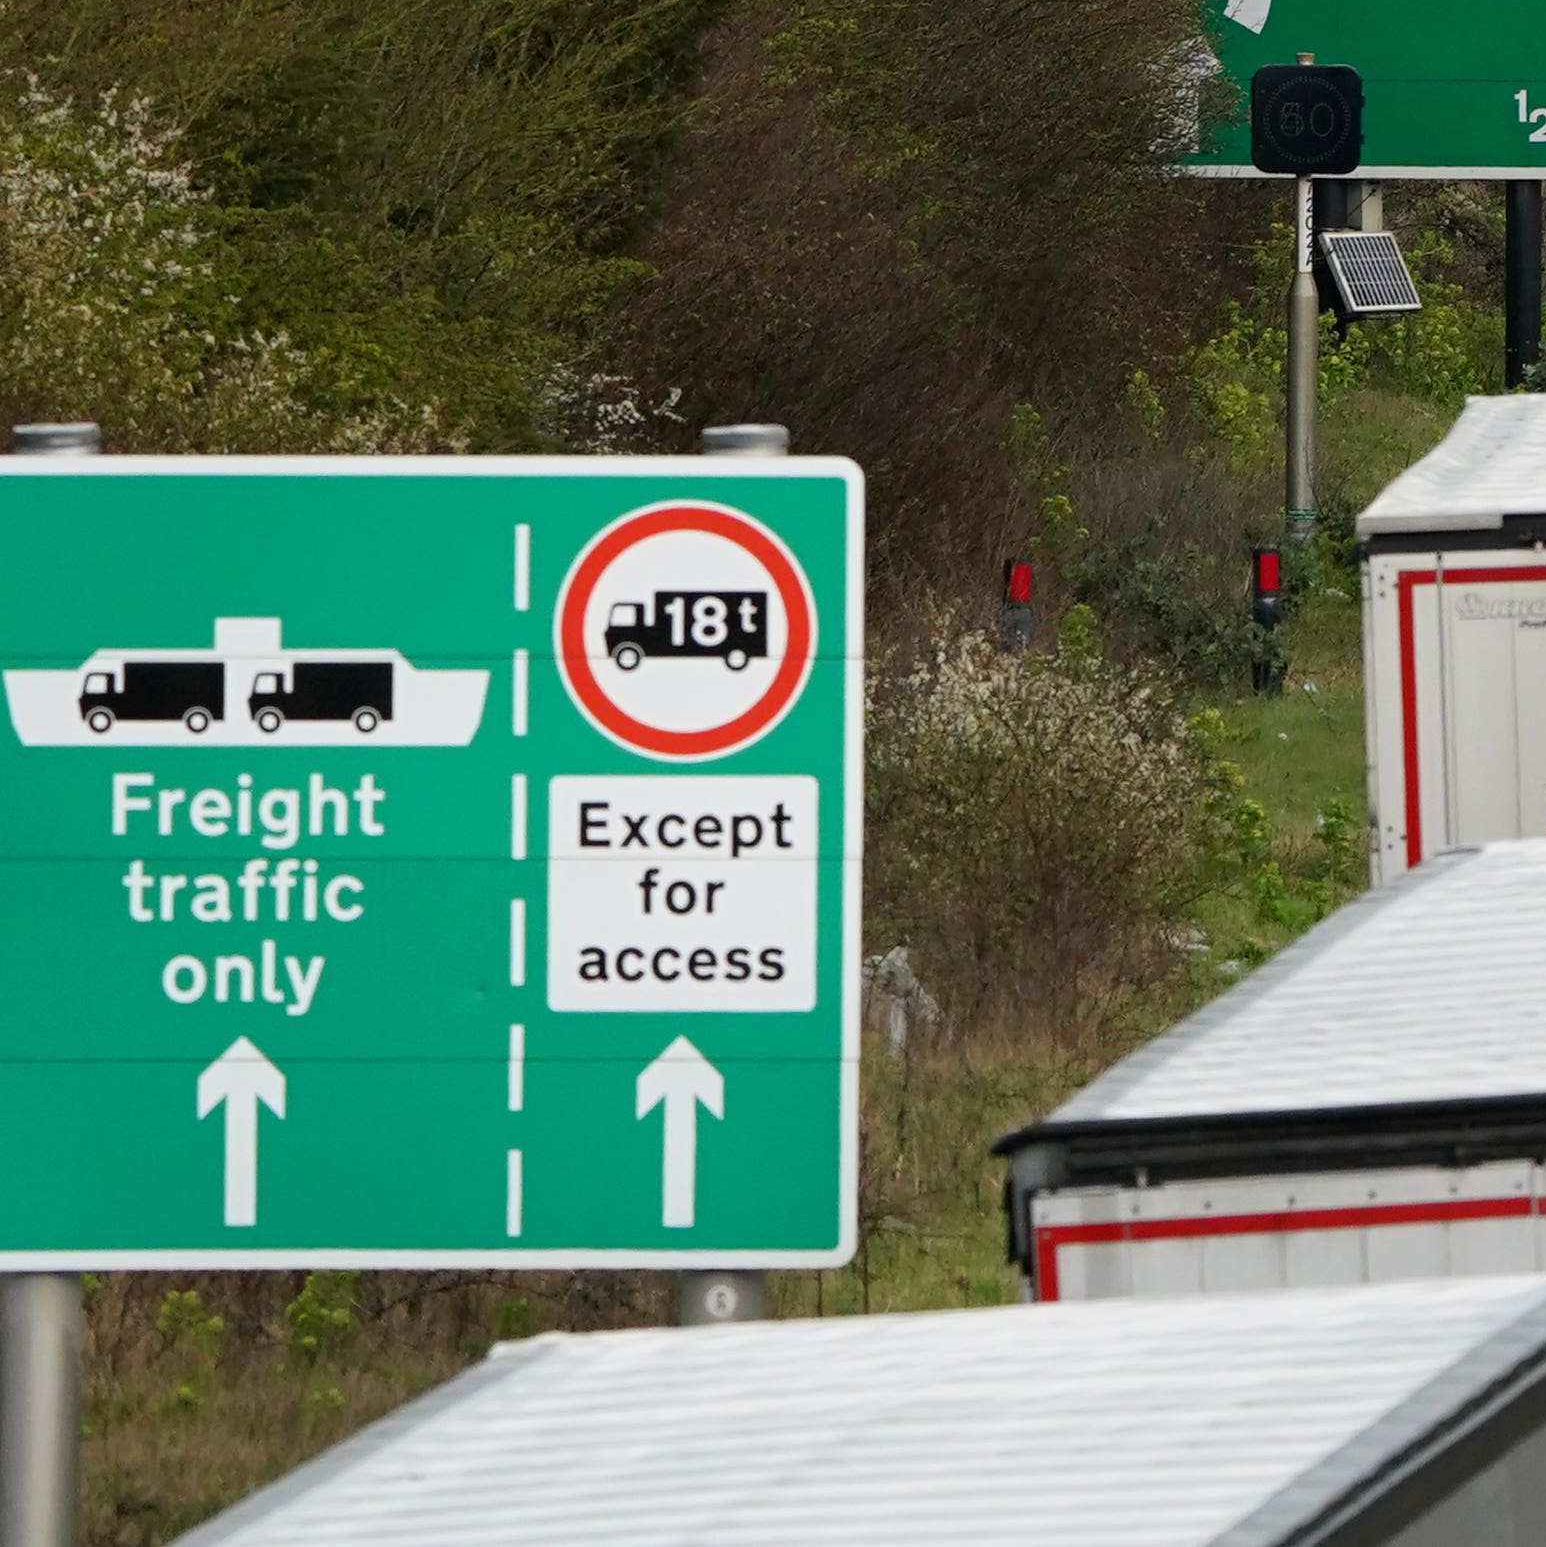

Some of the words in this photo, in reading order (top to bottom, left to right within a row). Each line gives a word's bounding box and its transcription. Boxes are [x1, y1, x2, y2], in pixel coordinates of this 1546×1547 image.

[111, 772, 385, 849] Freight
[579, 801, 794, 857] Except
[123, 859, 364, 923] traffic
[637, 867, 726, 915] for
[161, 939, 326, 1016] only
[578, 944, 786, 985] access
